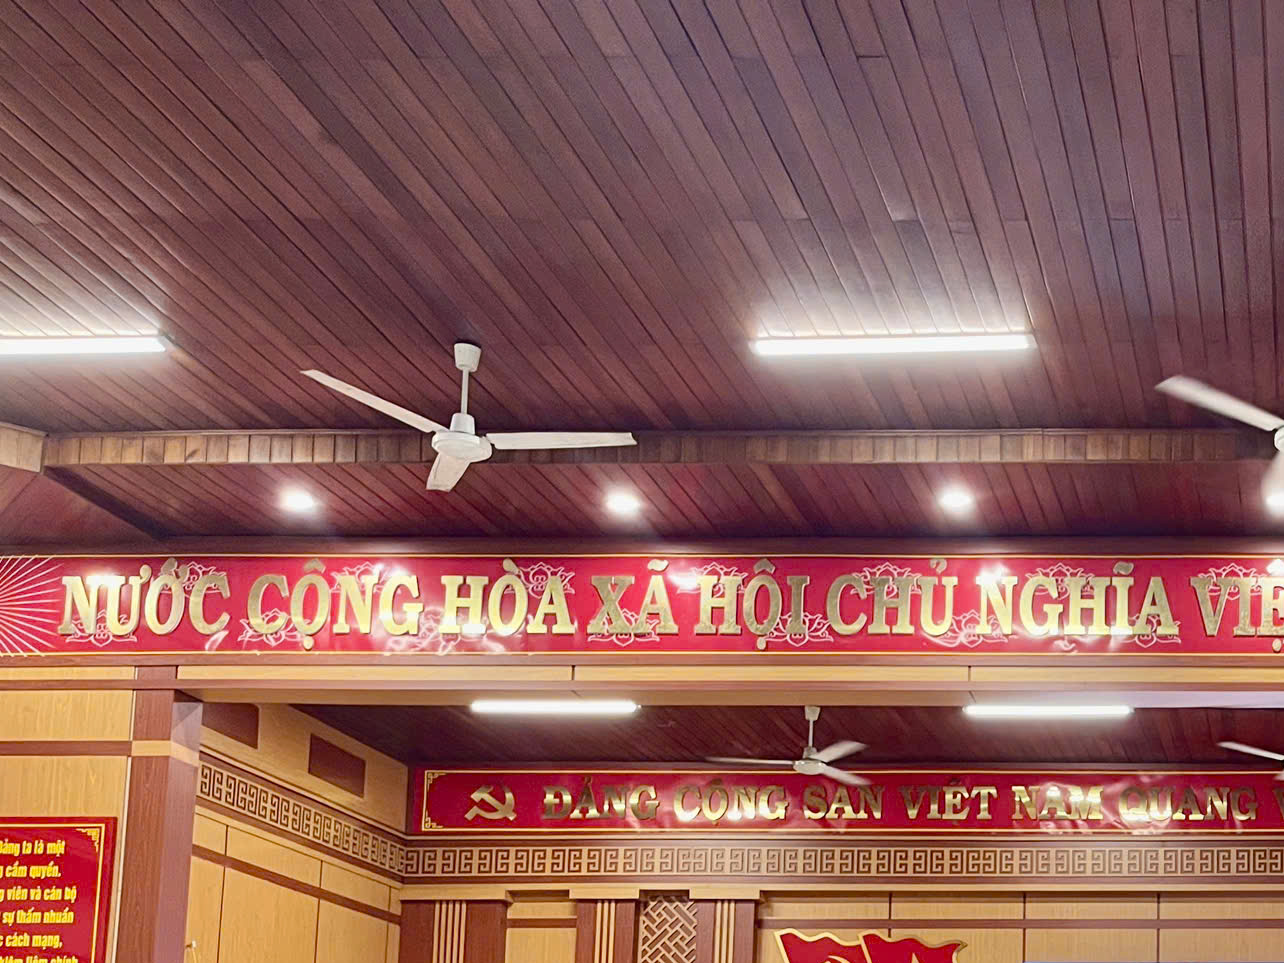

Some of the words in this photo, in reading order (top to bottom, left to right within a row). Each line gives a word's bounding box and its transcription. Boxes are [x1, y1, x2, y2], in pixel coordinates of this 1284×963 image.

[57, 558, 232, 636] NƯỚC
[245, 558, 425, 650] CỘNG
[439, 558, 577, 636] HÒA
[586, 559, 679, 635] XÃ
[693, 558, 810, 650] HỘI
[825, 558, 958, 636] CHỦ
[975, 560, 1180, 636] NGHĨA
[543, 776, 660, 820] ĐẢNG
[673, 778, 789, 826] CỘNG
[900, 777, 998, 825] VIỆT
[1011, 785, 1104, 820] NAM
[1118, 785, 1258, 821] QUANG
[22, 840, 32, 854] ta
[7, 886, 28, 900] viên
[30, 886, 41, 900] và
[43, 885, 62, 900] cán
[5, 932, 30, 947] cách
[31, 935, 62, 950] mạng,
